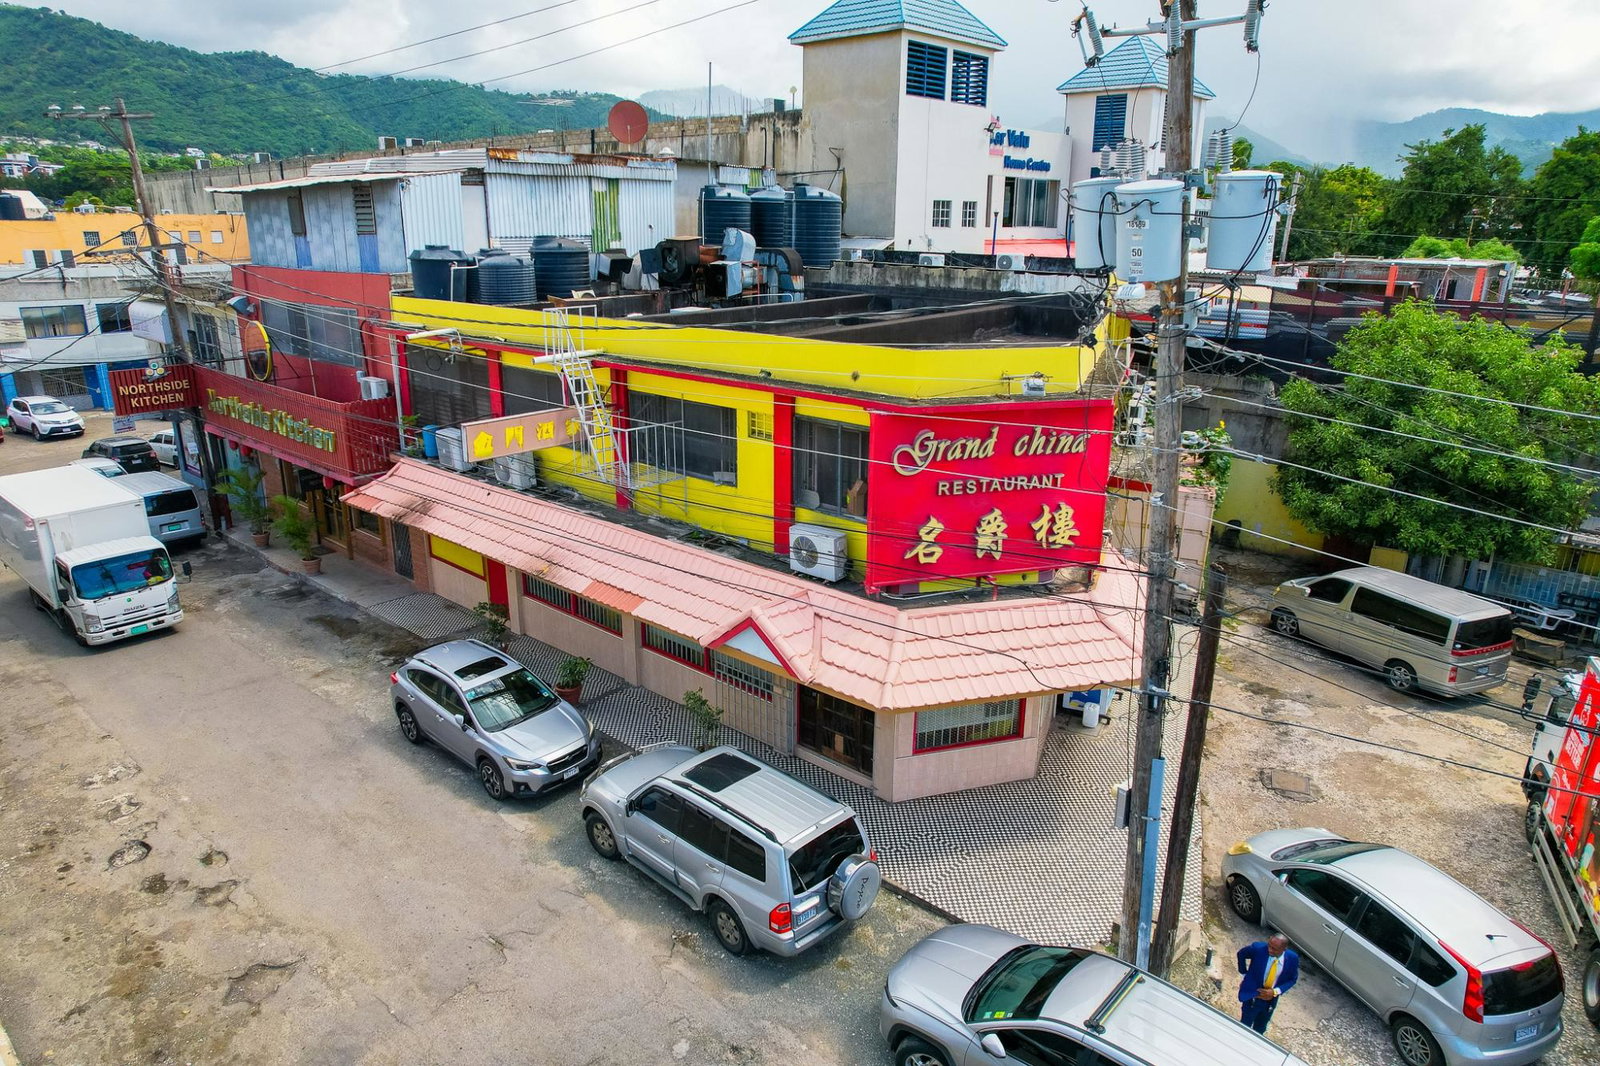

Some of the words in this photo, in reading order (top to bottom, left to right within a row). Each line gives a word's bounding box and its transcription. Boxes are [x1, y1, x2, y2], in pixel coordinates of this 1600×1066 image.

[1007, 129, 1030, 149] Valu
[1131, 248, 1143, 257] 50
[119, 379, 191, 396] NORTHSIDE
[130, 393, 184, 408] KITCHEN
[272, 408, 336, 453] Kitchen
[893, 426, 1000, 476] Grand
[1014, 426, 1089, 456] china
[937, 474, 1065, 496] RESTAURANT
[904, 501, 1081, 565] 名爵樓
